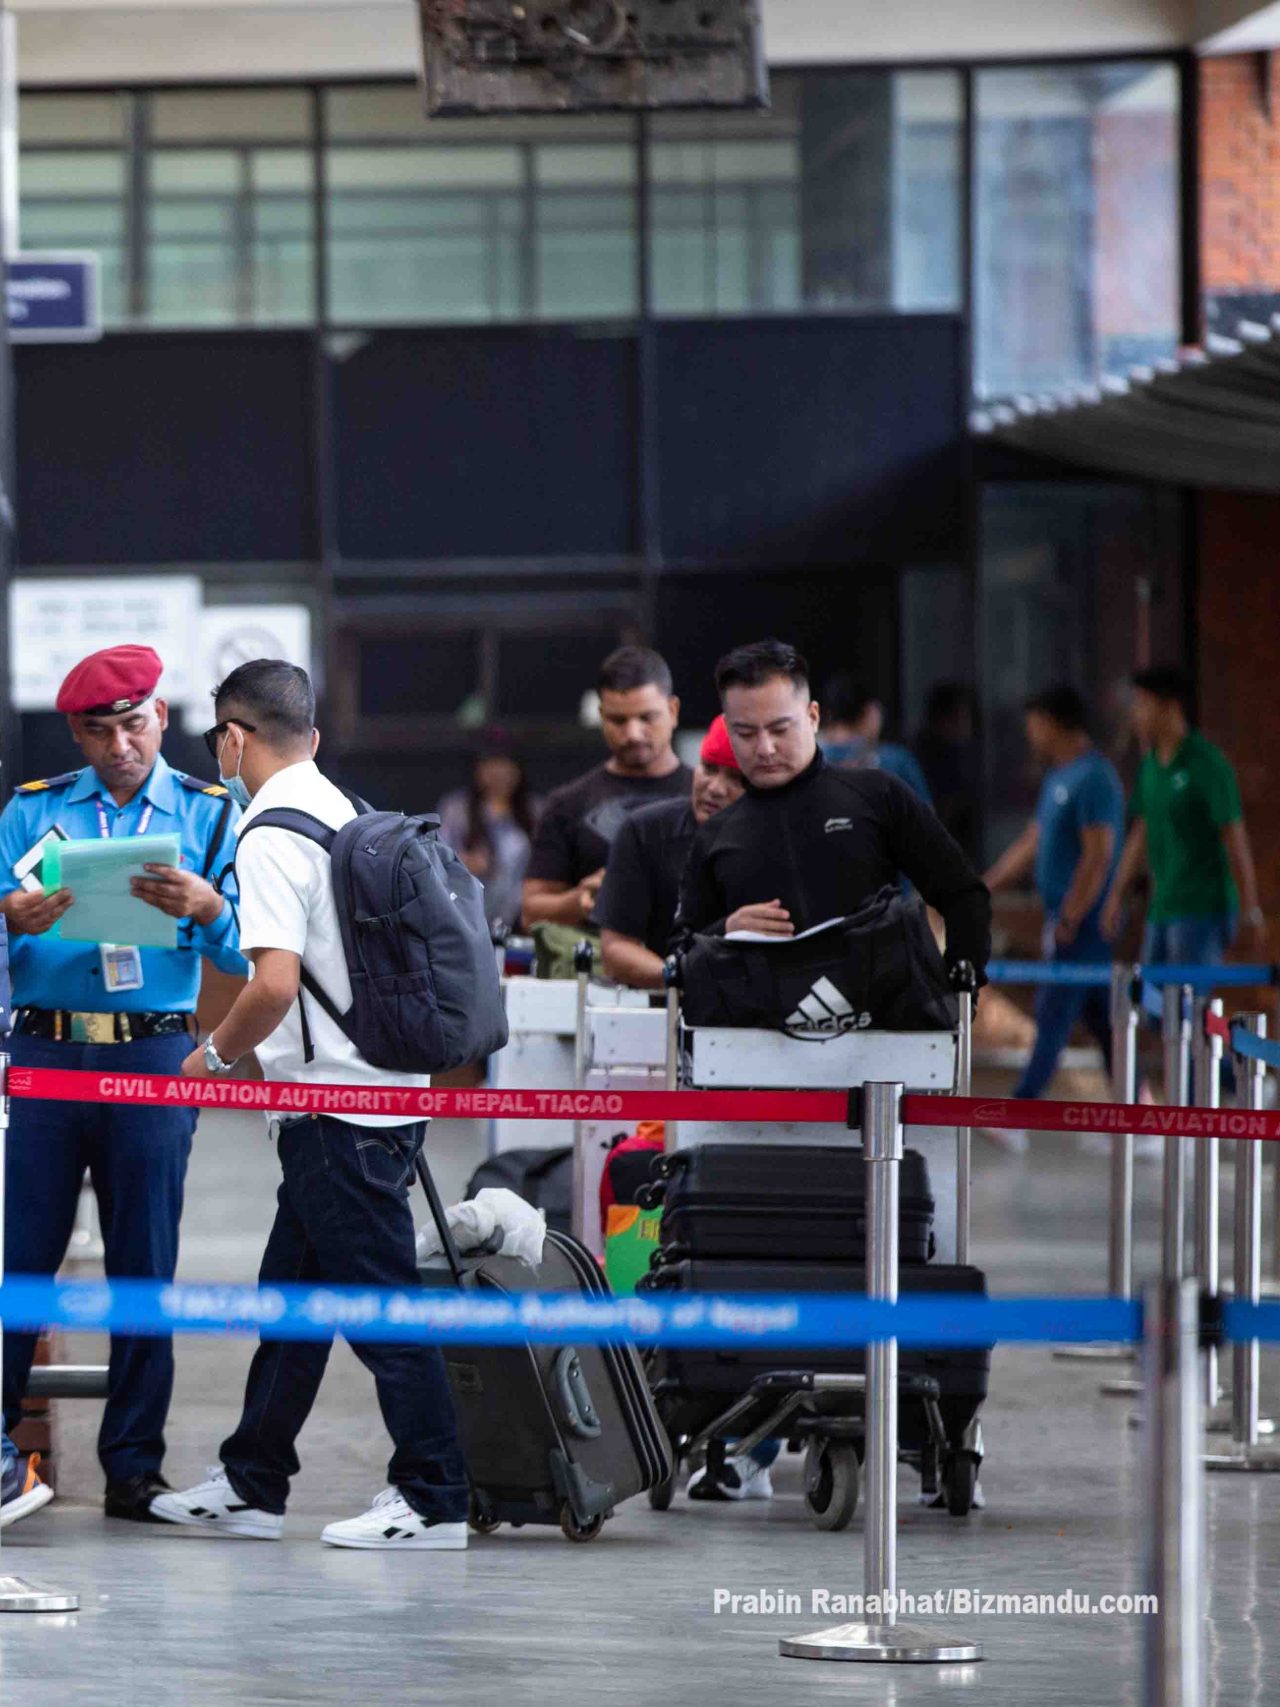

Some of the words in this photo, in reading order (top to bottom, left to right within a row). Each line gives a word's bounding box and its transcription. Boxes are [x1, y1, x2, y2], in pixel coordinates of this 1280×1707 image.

[98, 1077, 157, 1098] CIVIL
[164, 1079, 270, 1104] AVIATION
[277, 1085, 411, 1111] AUTHORITY
[418, 1091, 448, 1112] OF
[1062, 1106, 1131, 1128] CIVIL
[1139, 1110, 1268, 1136] AVIATION
